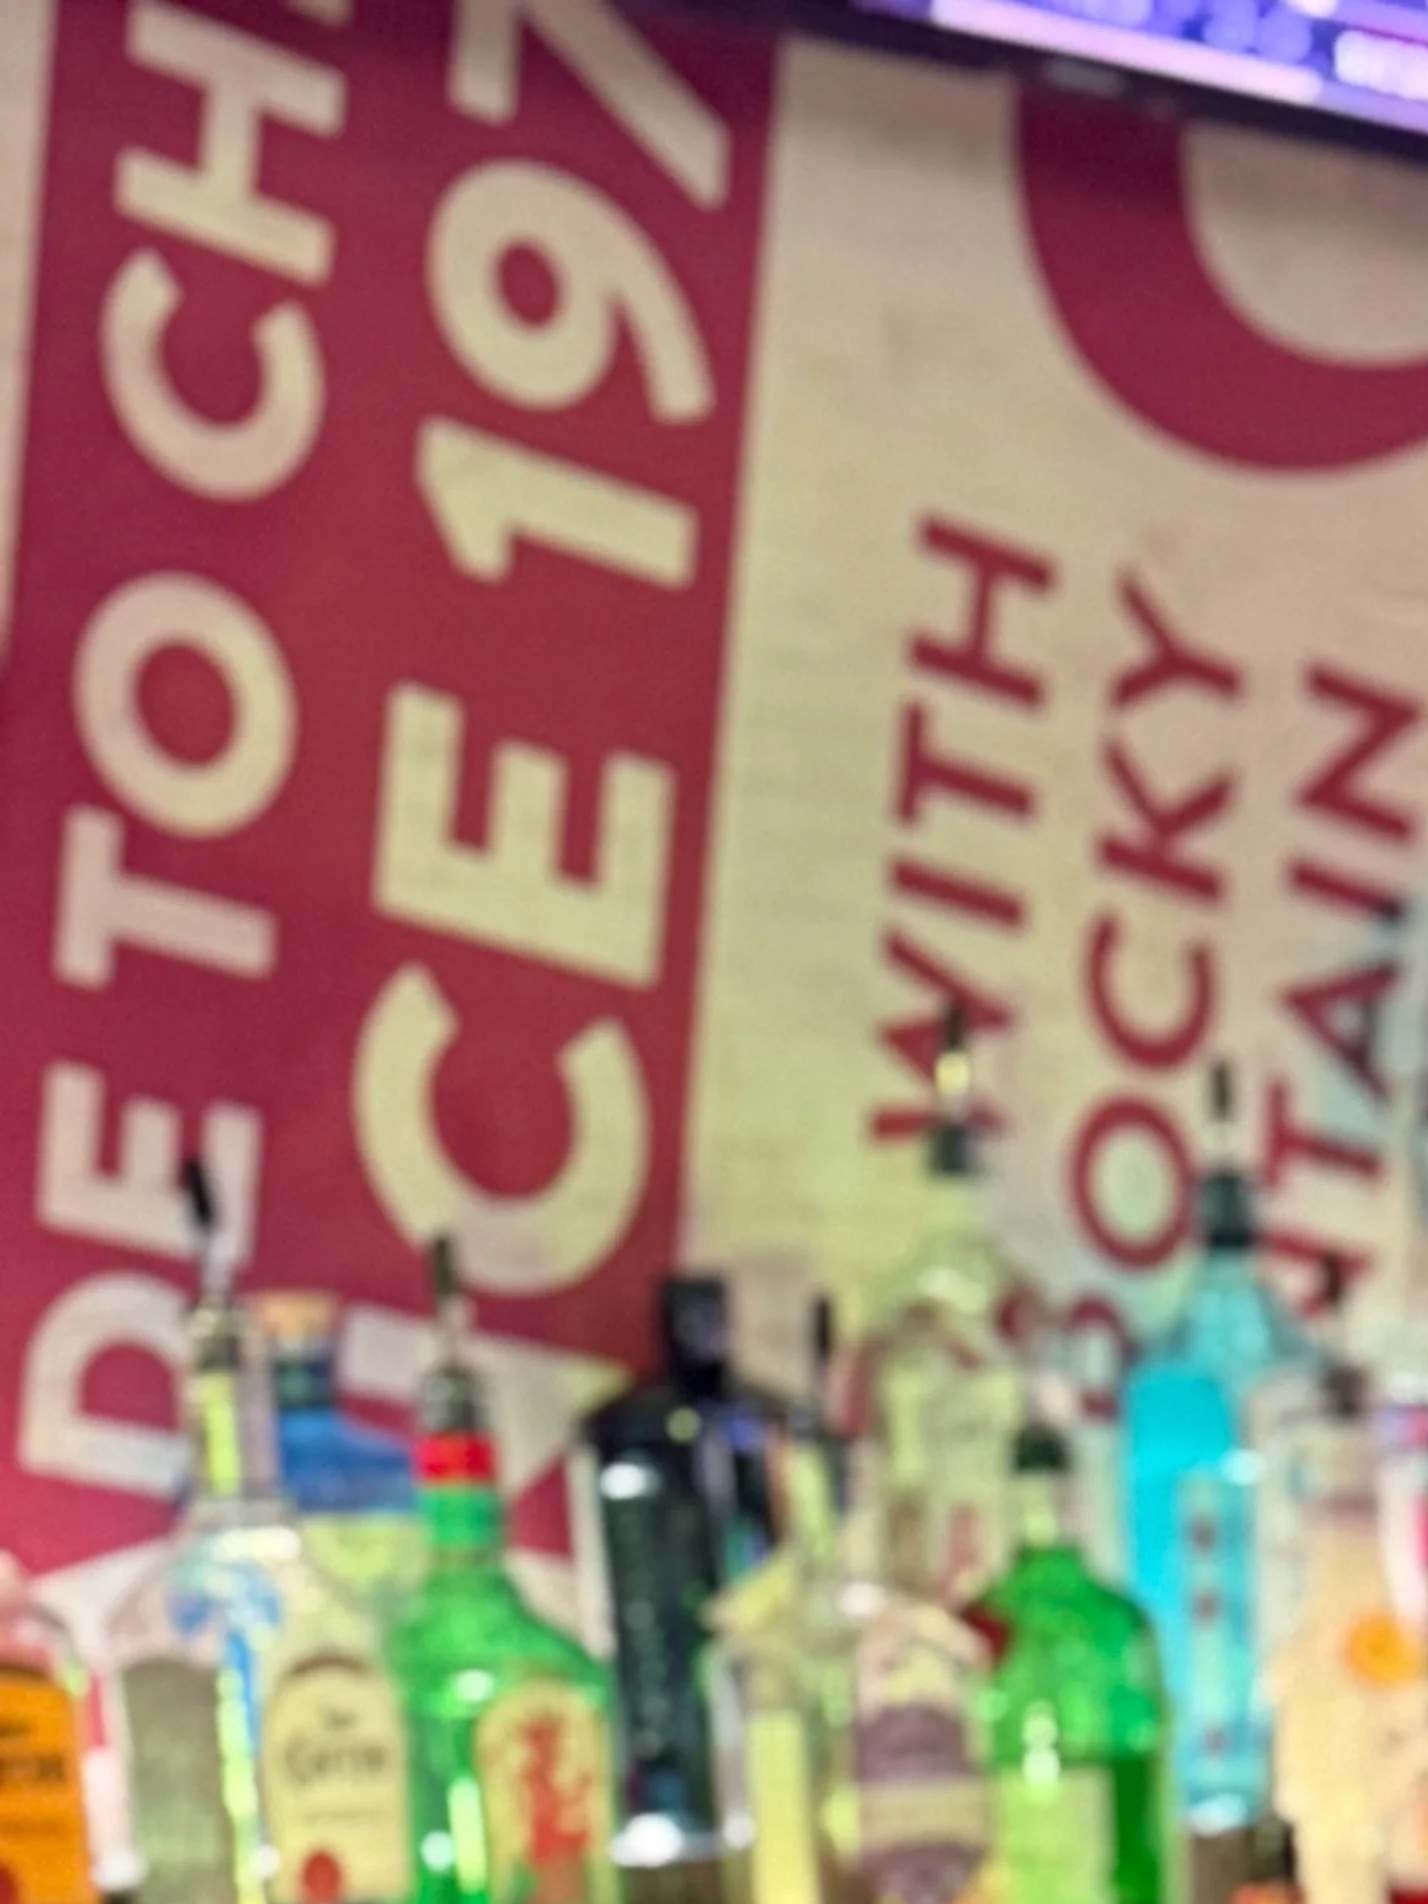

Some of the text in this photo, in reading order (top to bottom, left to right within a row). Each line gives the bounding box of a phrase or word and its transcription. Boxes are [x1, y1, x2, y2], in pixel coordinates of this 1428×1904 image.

[100, 0, 350, 501] CH
[53, 571, 300, 988] TO
[866, 512, 1058, 1145] WITH
